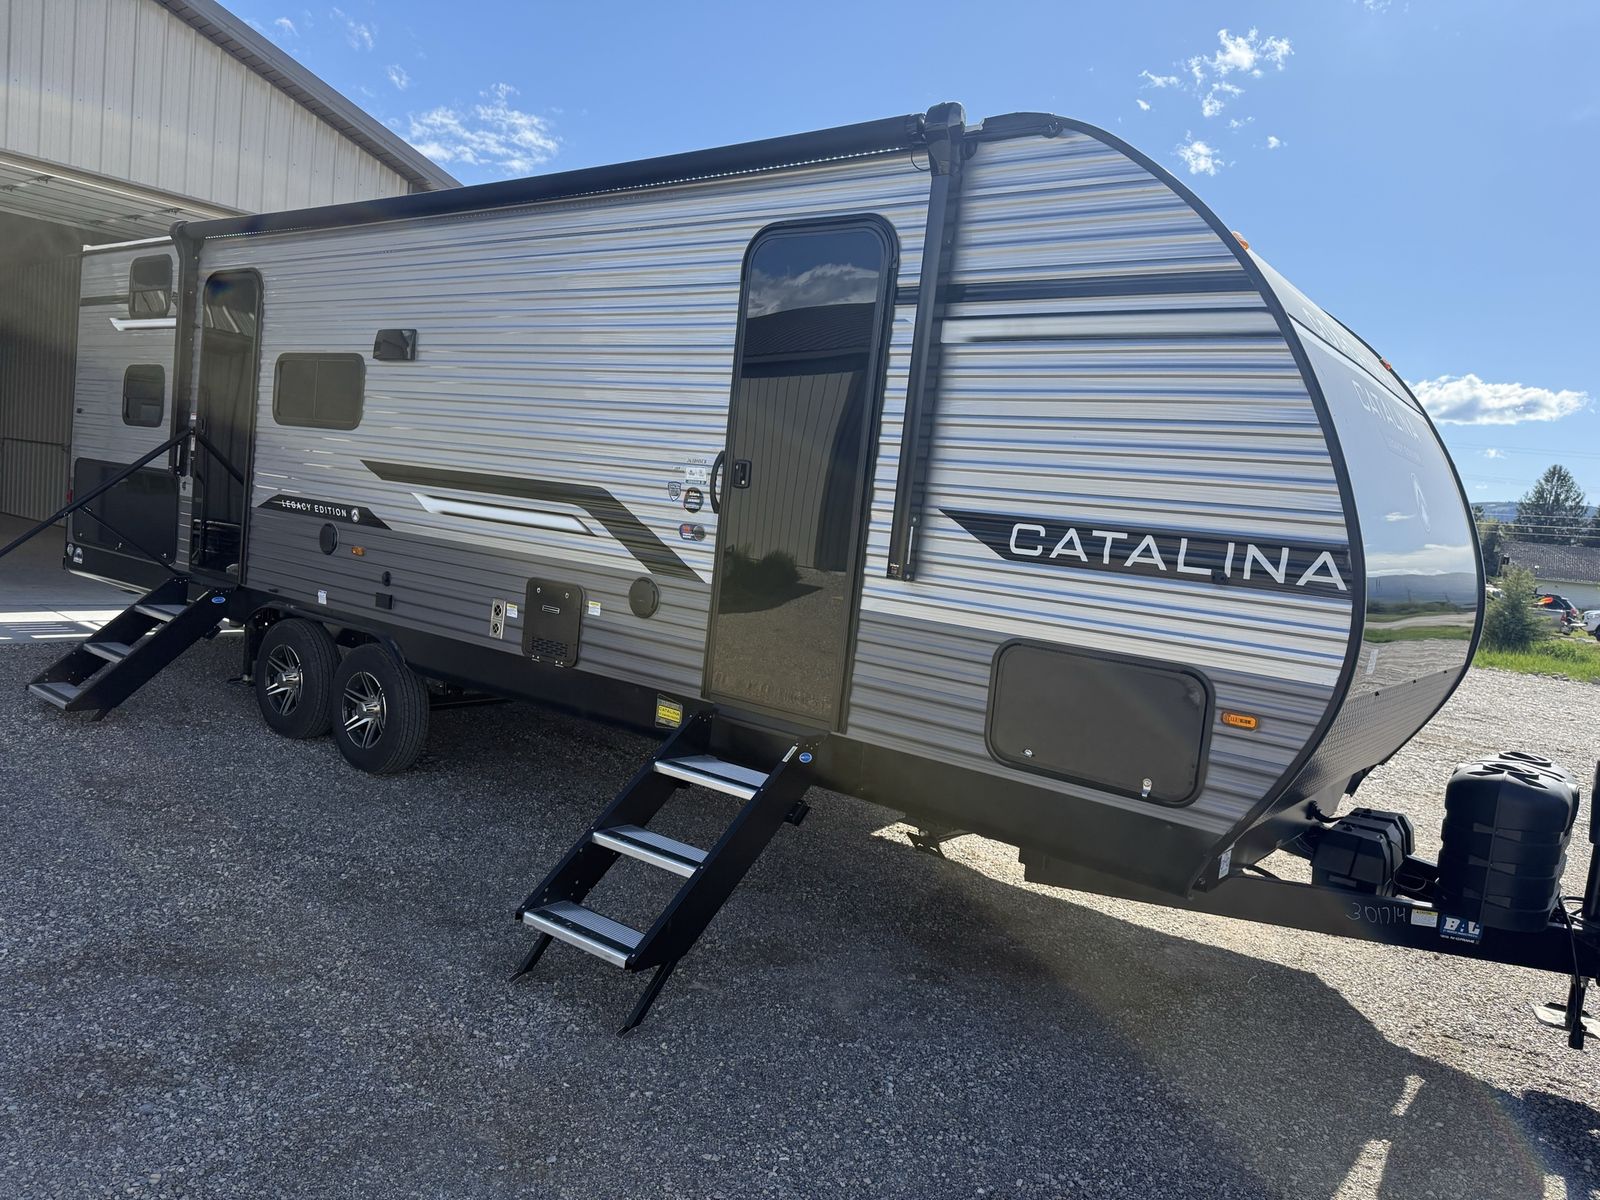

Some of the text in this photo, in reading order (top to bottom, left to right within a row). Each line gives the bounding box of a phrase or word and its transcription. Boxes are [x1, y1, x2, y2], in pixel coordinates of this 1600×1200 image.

[281, 499, 348, 517] LEGACY EDITION
[1009, 522, 1348, 591] CATALINA
